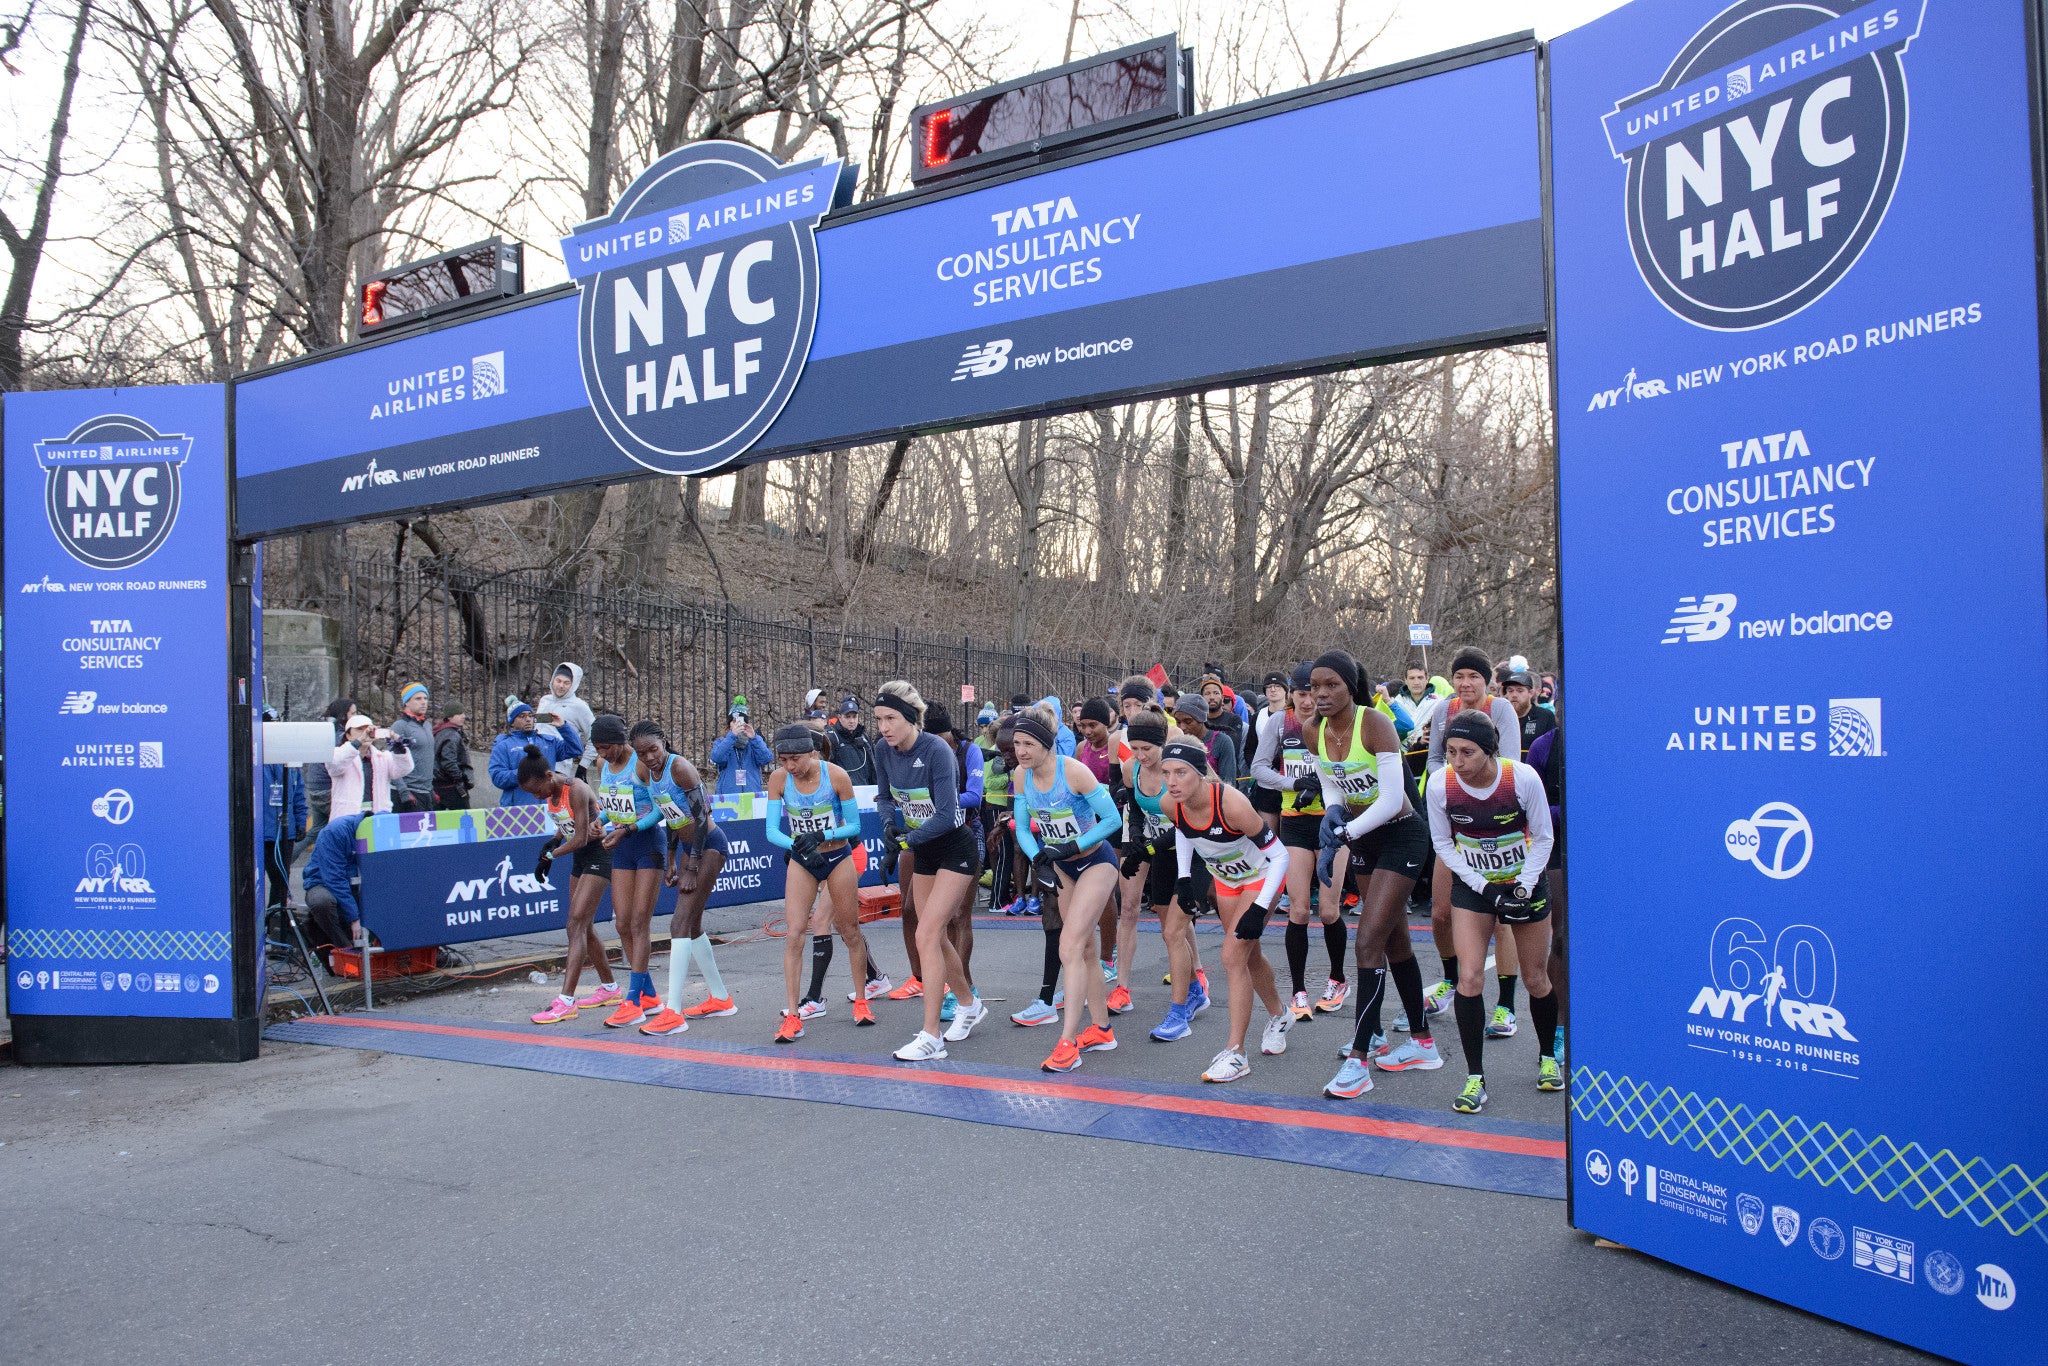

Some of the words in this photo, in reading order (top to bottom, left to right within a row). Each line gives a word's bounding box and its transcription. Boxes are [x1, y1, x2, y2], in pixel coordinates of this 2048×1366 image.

[1626, 86, 1720, 136] UNITED
[1758, 9, 1900, 83] AIRLINES
[1665, 75, 1856, 221] NYC
[580, 226, 663, 262] UNITED
[696, 184, 815, 232] AIRLINES
[991, 196, 1079, 237] TATA
[1679, 177, 1841, 280] HALF
[936, 213, 1142, 282] CONSULTANCY
[973, 257, 1102, 307] SERVICES
[614, 240, 776, 354] NYC
[1015, 351, 1052, 371] new
[1055, 336, 1134, 363] balance
[1676, 365, 1723, 392] NEW
[1729, 350, 1788, 378] YORK
[1793, 334, 1859, 365] ROAD
[1865, 303, 1982, 346] RUNNERS
[388, 365, 465, 396] UNITED
[626, 337, 763, 416] HALF
[370, 384, 466, 420] AIRLINES
[47, 449, 97, 459] UNITED
[115, 446, 179, 457] AIRLINES
[403, 468, 426, 481] NEW
[428, 463, 456, 477] YORK
[458, 456, 487, 471] ROAD
[489, 446, 541, 465] RUNNERS
[1721, 429, 1811, 469] TATA
[66, 467, 159, 508] NYC
[1666, 457, 1876, 515] CONSULTANCY
[72, 511, 152, 539] HALF
[1702, 504, 1836, 548] SERVICES
[69, 583, 94, 592] NEW
[96, 582, 124, 591] YORK
[126, 581, 156, 591] ROAD
[158, 580, 207, 590] RUNNERS
[90, 619, 133, 634] TATA
[1739, 617, 1786, 639] new
[1790, 610, 1893, 636] balance
[62, 637, 162, 652] CONSULTANCY
[80, 655, 143, 669] SERVICES
[97, 703, 120, 714] new
[122, 702, 168, 714] balance
[1694, 704, 1817, 725] UNITED
[75, 745, 135, 755] UNITED
[1666, 732, 1817, 751] AIRLINES
[61, 756, 135, 767] AIRLINES
[1336, 774, 1378, 793] HURA
[93, 803, 109, 811] abc
[1727, 830, 1758, 846] abc
[86, 843, 146, 880] 60
[1214, 860, 1251, 876] SON
[1464, 845, 1525, 870] LINDEN
[446, 910, 482, 927] RUN
[488, 905, 521, 920] FOR
[526, 899, 560, 915] LIFE
[1710, 917, 1837, 1003] 60
[1687, 1024, 1714, 1038] NEW
[1718, 1029, 1750, 1045] YORK
[1755, 1036, 1790, 1052] ROAD
[1795, 1043, 1860, 1065] RUNNERS
[1732, 1050, 1762, 1062] 1958
[1775, 1059, 1808, 1071] 2018
[1660, 1169, 1700, 1190] CENTRAL
[1703, 1181, 1727, 1198] PARK
[1660, 1182, 1727, 1210] CONSERVANCY
[1660, 1198, 1685, 1212] central
[1686, 1206, 1694, 1214] to
[1696, 1208, 1708, 1219] the
[1709, 1214, 1727, 1226] park
[1856, 1230, 1872, 1241] NEW
[1875, 1236, 1893, 1247] YORK
[1896, 1242, 1912, 1252] CITY
[1977, 1272, 2008, 1298] MTA
